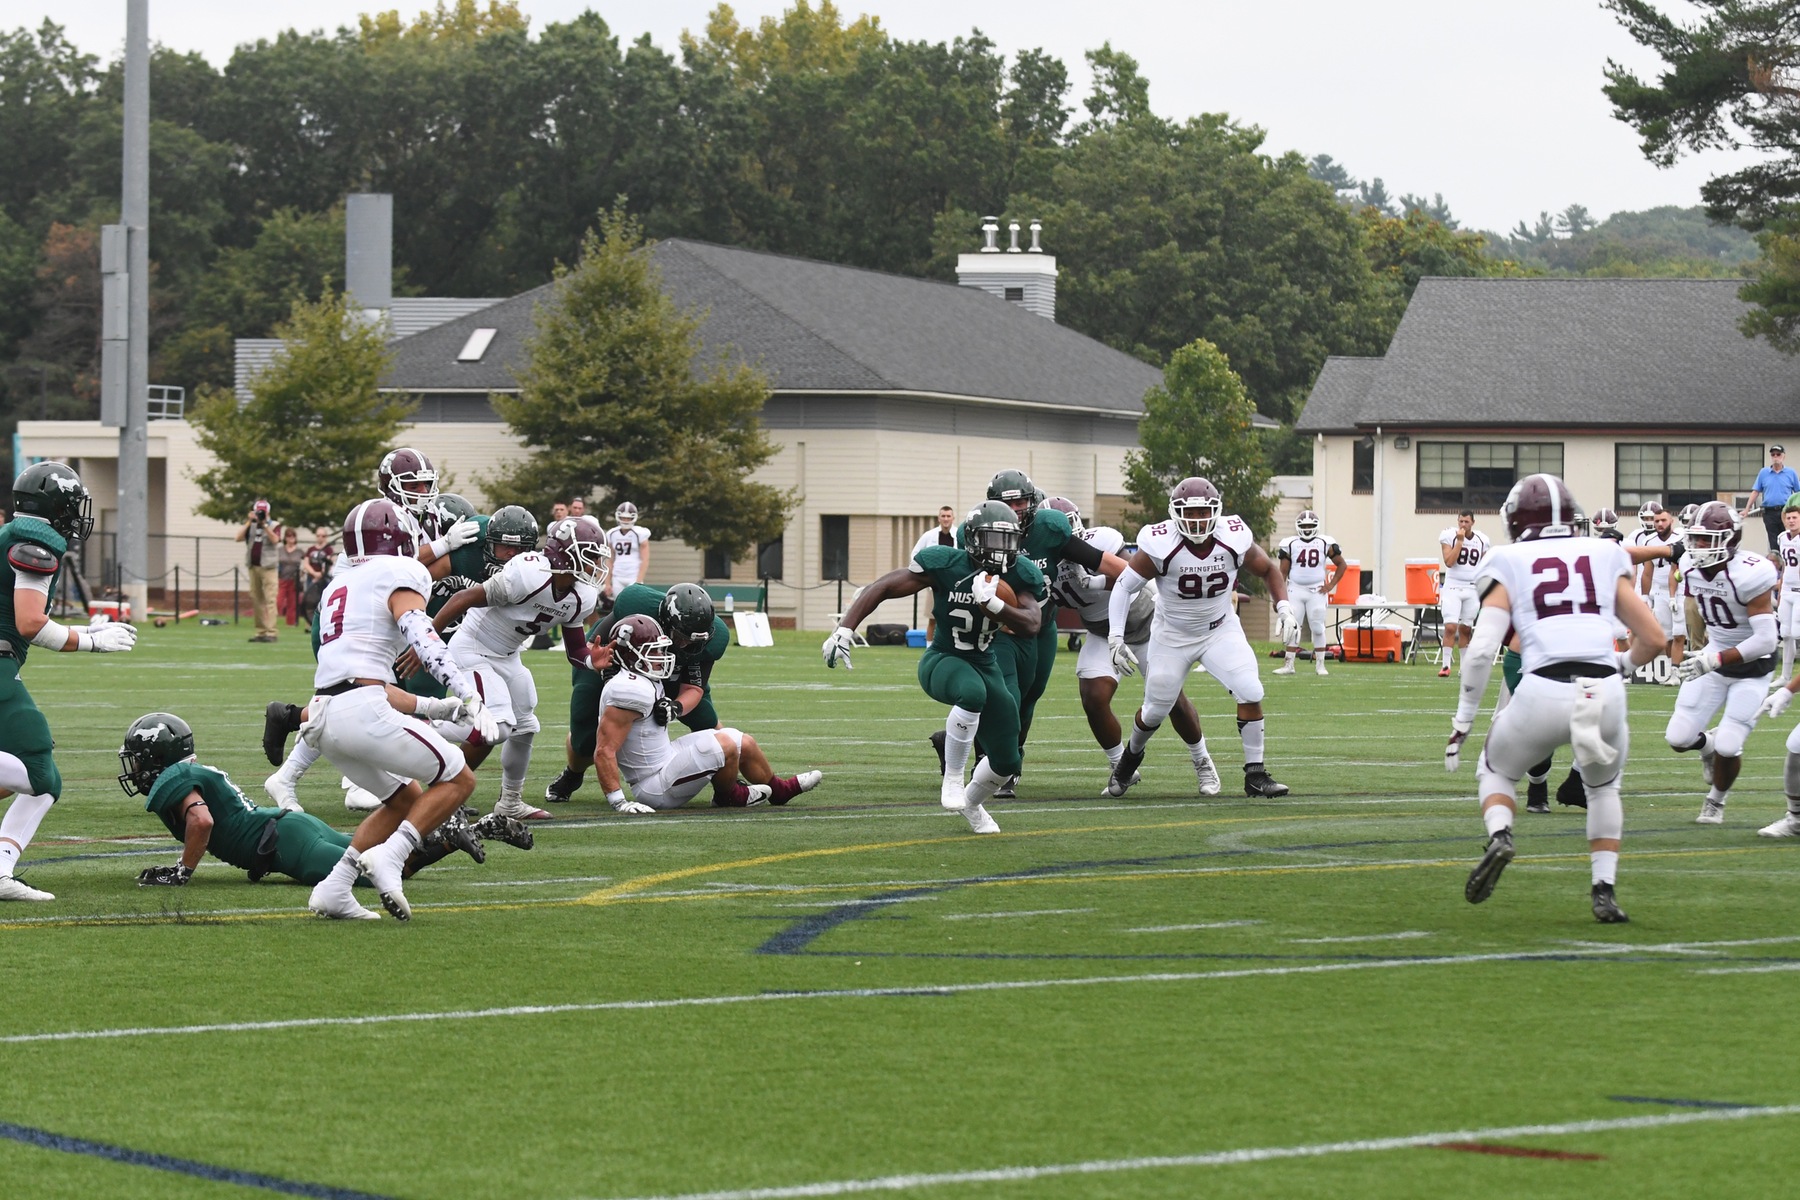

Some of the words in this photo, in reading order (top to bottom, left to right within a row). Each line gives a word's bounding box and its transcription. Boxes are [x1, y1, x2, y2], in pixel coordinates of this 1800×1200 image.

[615, 542, 632, 555] 97
[1296, 548, 1319, 568] 48
[1457, 547, 1480, 567] 89
[1782, 548, 1799, 567] 16
[1180, 564, 1226, 573] SPRINGFIELD
[1742, 556, 1760, 567] 10
[1178, 572, 1229, 599] 92
[1532, 556, 1600, 620] 21
[322, 585, 348, 646] 3
[533, 603, 567, 617] SPRINGFIELD
[1697, 594, 1739, 629] 10
[515, 612, 554, 635] 5
[1635, 655, 1671, 683] 40
